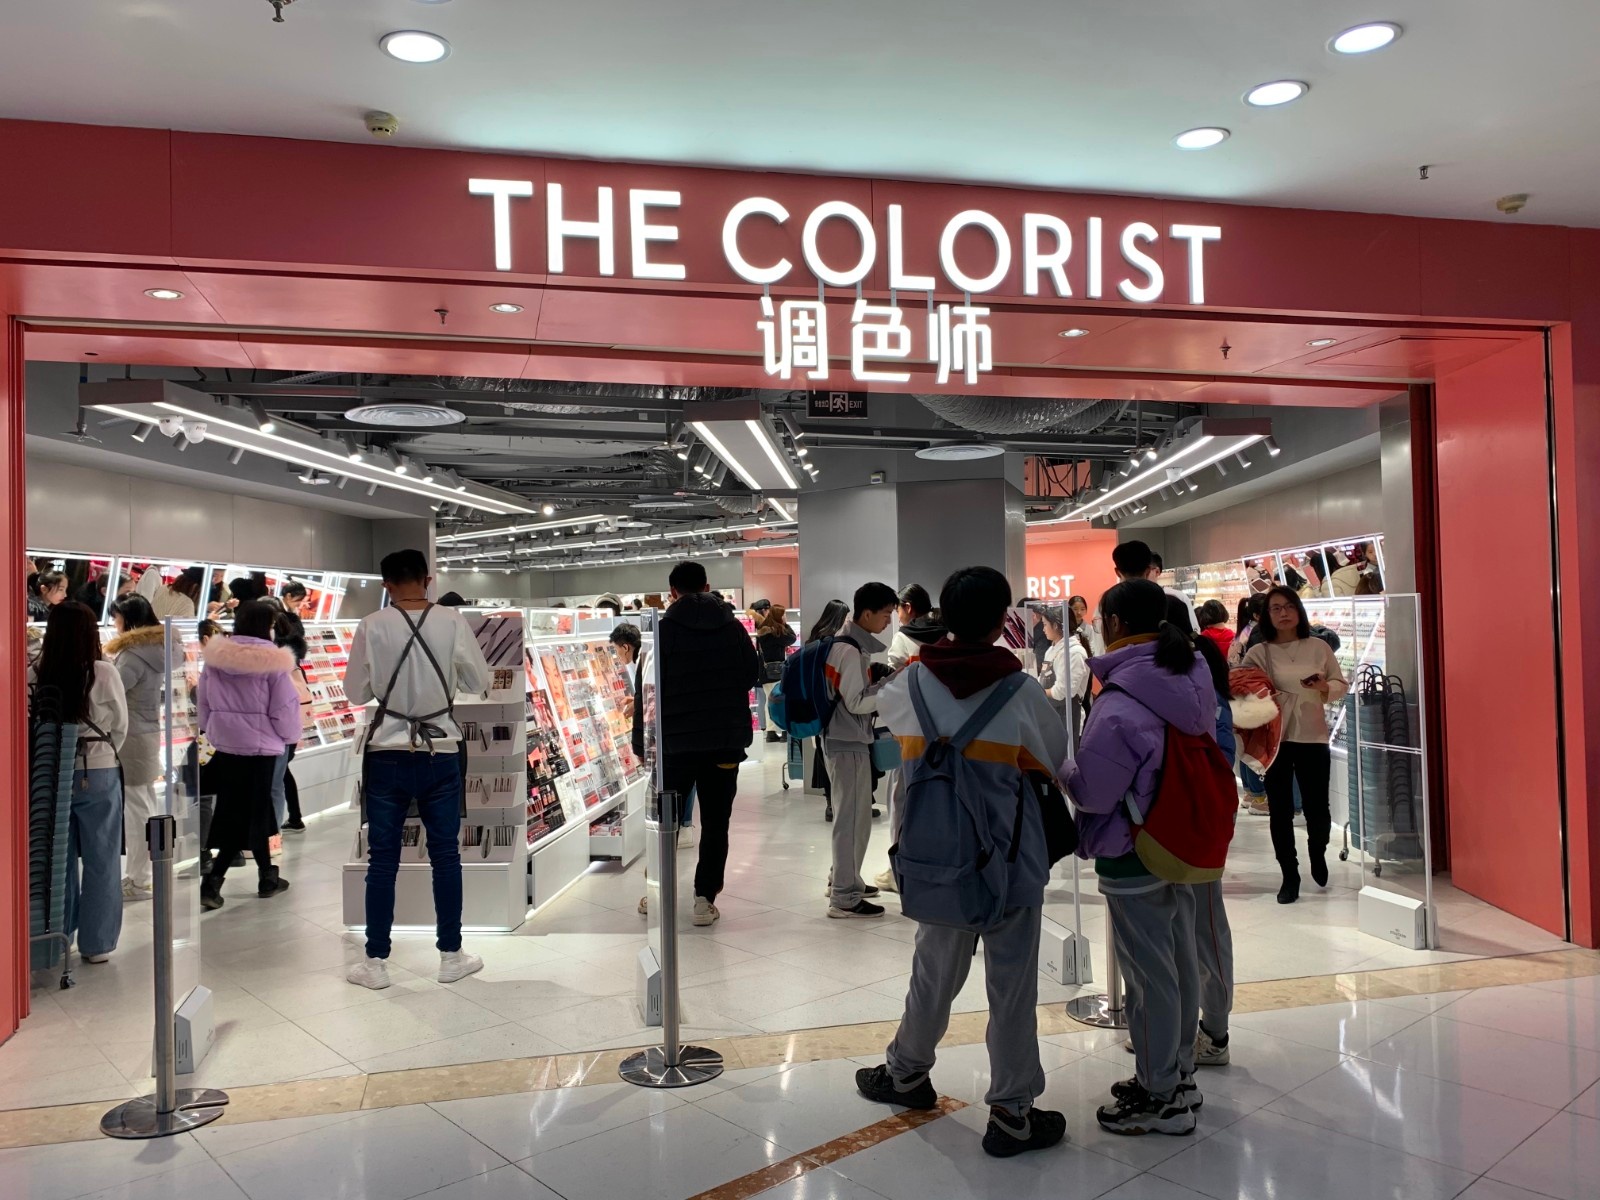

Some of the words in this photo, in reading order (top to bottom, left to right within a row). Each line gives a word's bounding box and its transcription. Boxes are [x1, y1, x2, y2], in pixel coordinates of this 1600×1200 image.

[468, 178, 688, 280] THE
[721, 196, 1223, 305] COLORIST
[756, 296, 994, 385] 调色师
[849, 400, 863, 409] EXIT
